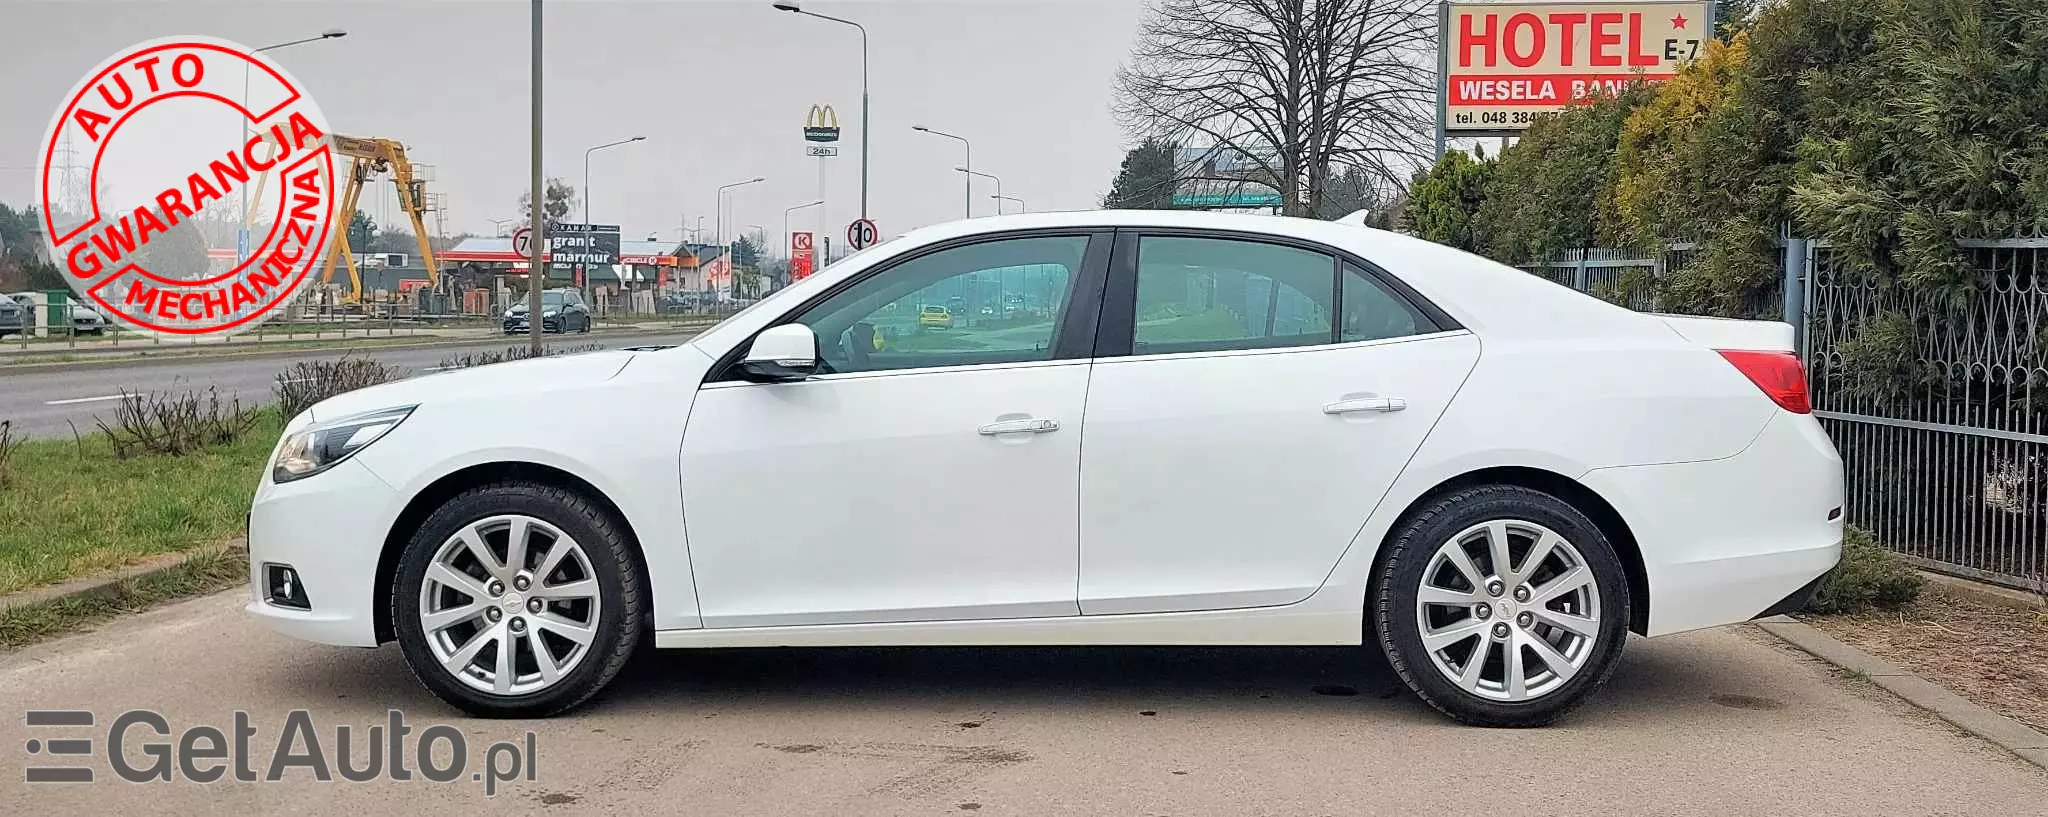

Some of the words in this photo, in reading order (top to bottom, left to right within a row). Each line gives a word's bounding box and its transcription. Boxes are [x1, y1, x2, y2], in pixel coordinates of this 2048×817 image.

[1459, 12, 1659, 67] HOTEL
[1664, 39, 1699, 60] E-7
[1459, 80, 1556, 100] WESELA
[1455, 111, 1477, 124] tel.
[1481, 111, 1507, 124] 048
[1511, 111, 1536, 124] 384
[812, 147, 831, 155] 24h
[552, 236, 596, 249] grant
[552, 253, 610, 263] marmur
